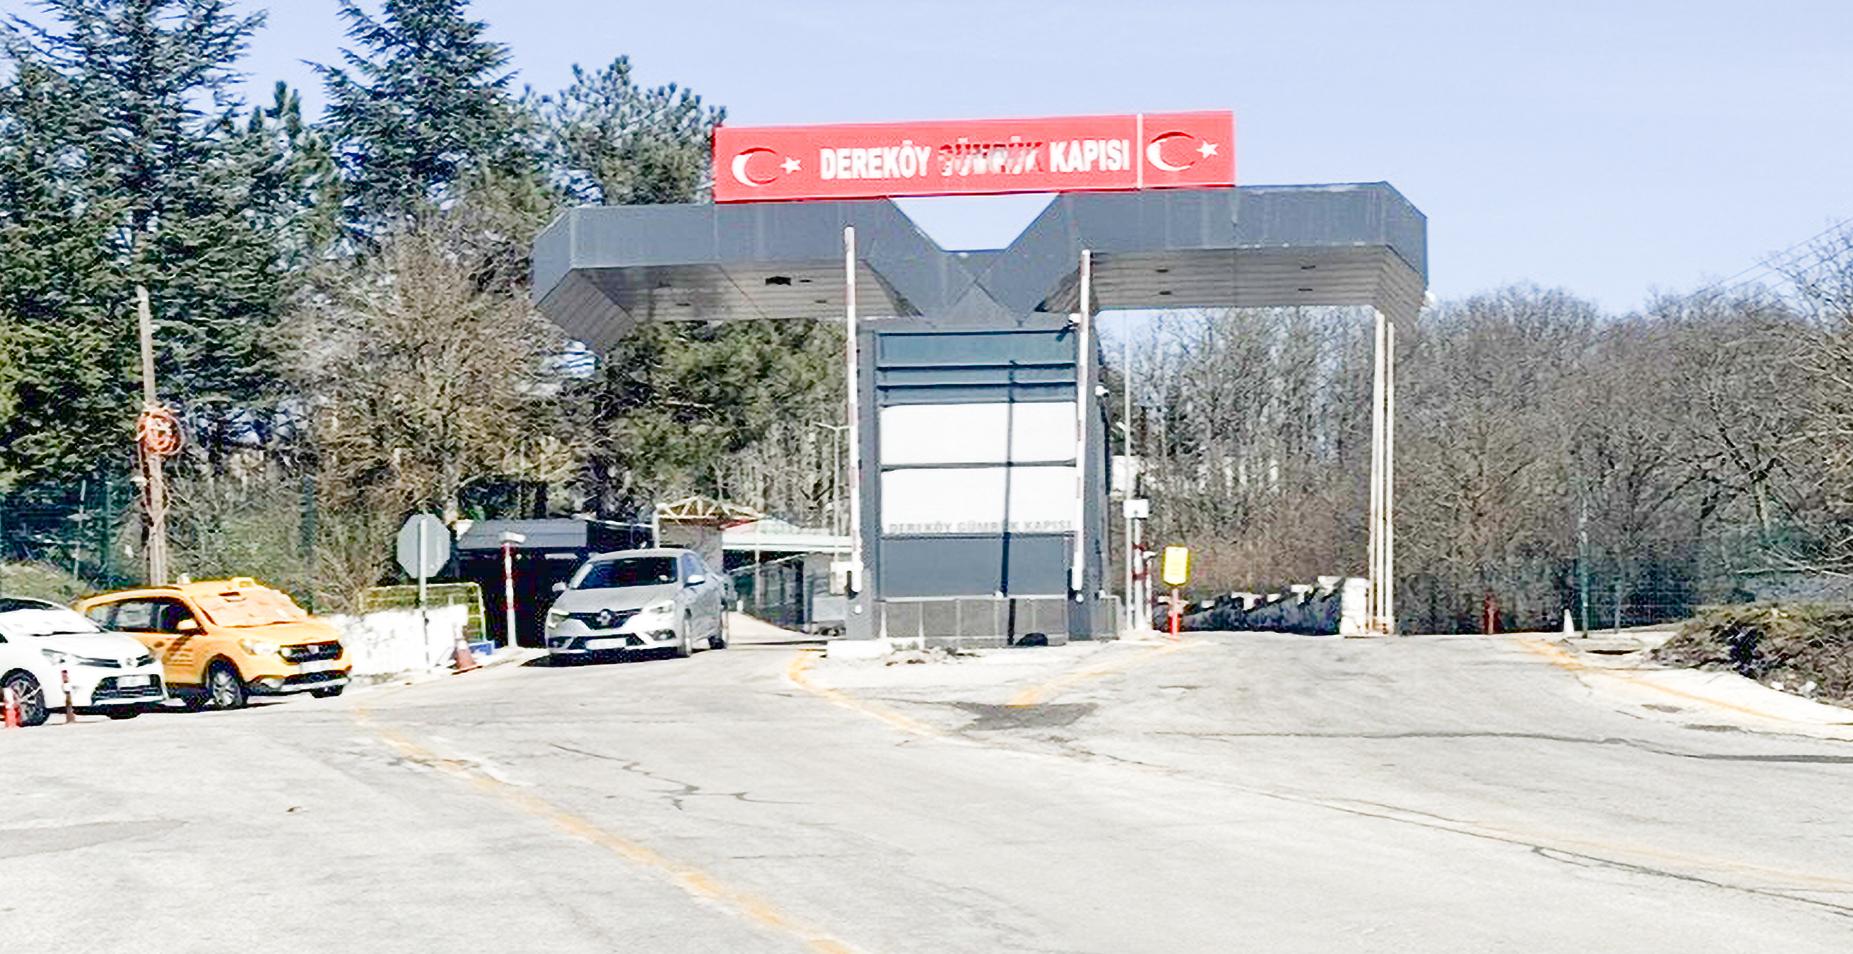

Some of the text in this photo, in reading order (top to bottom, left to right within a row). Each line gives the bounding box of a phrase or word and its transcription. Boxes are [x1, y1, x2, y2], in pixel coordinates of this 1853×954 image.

[820, 140, 931, 179] DEREKÖY
[1050, 139, 1130, 174] KAPISI
[957, 520, 1019, 533] GÜMRK
